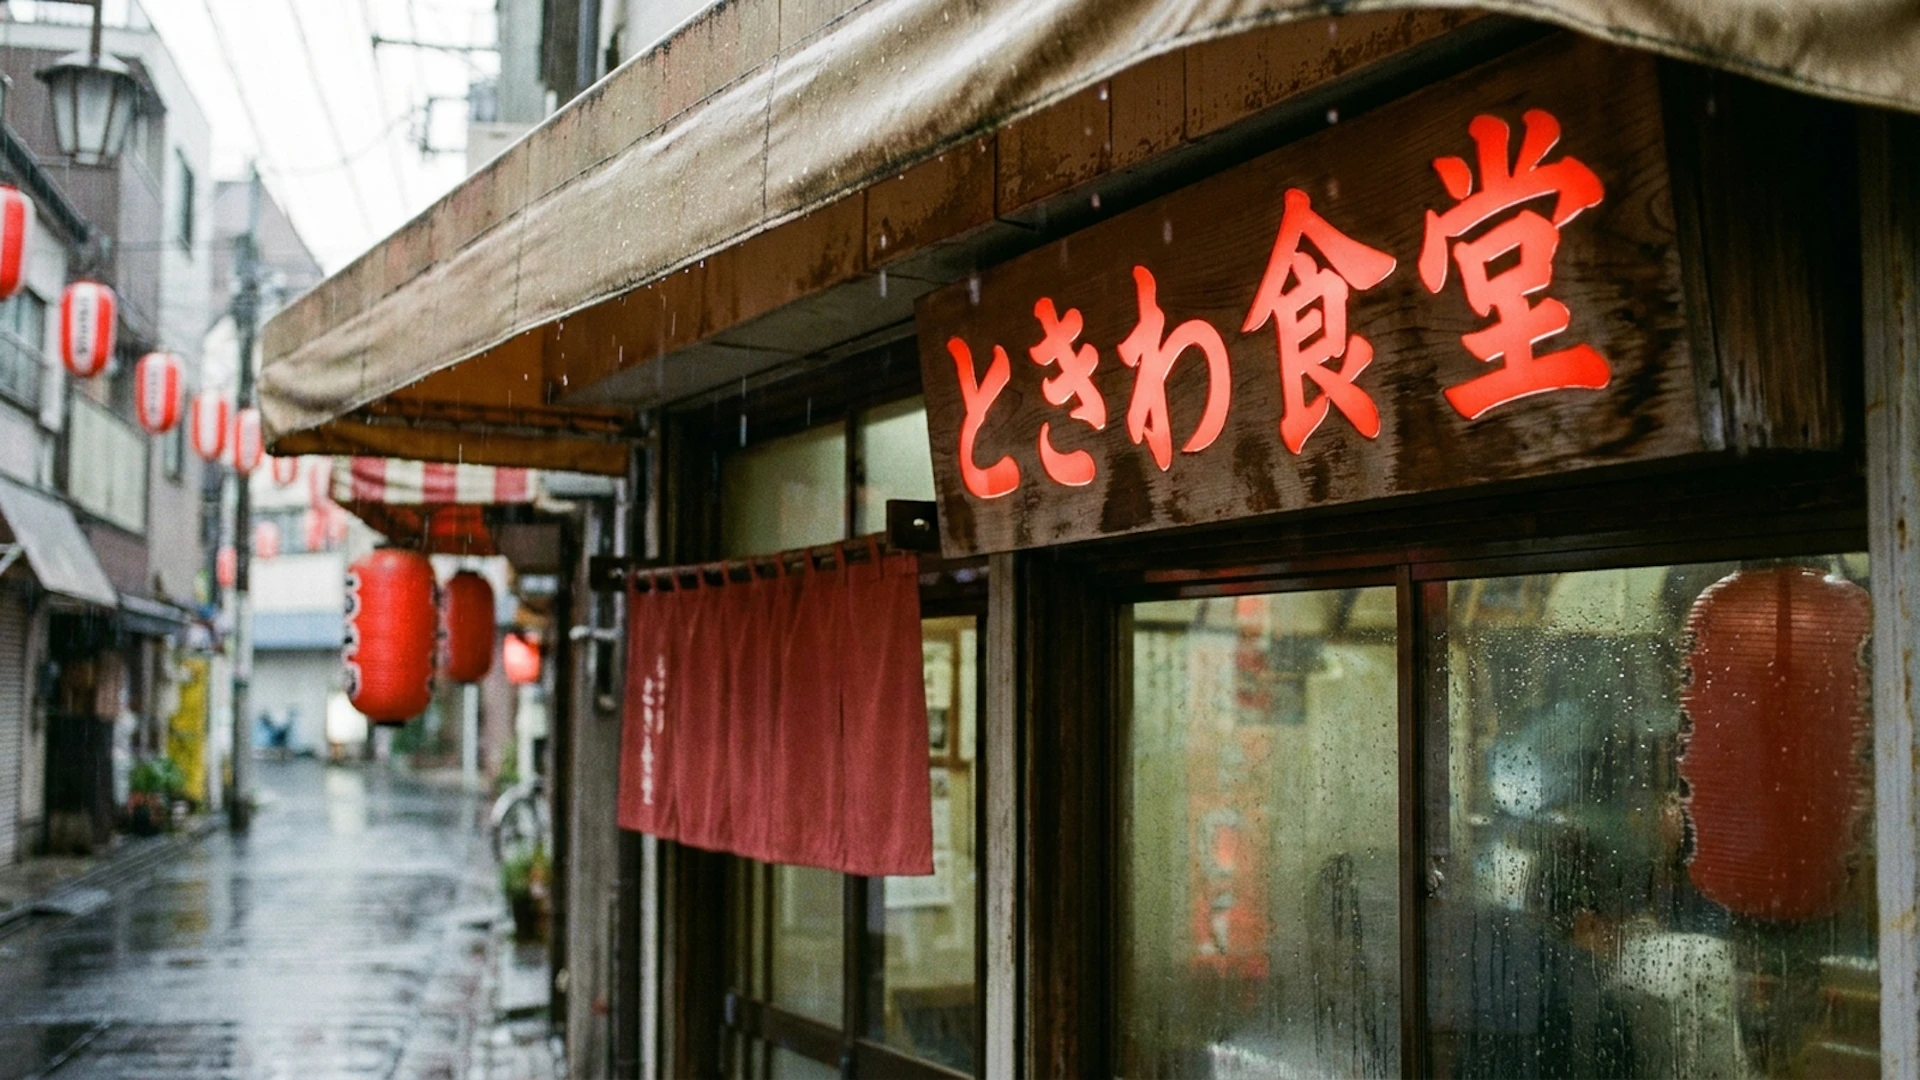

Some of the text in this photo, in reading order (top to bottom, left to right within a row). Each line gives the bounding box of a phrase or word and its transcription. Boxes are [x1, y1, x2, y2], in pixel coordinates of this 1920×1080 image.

[947, 109, 1611, 499] ときわ食堂
